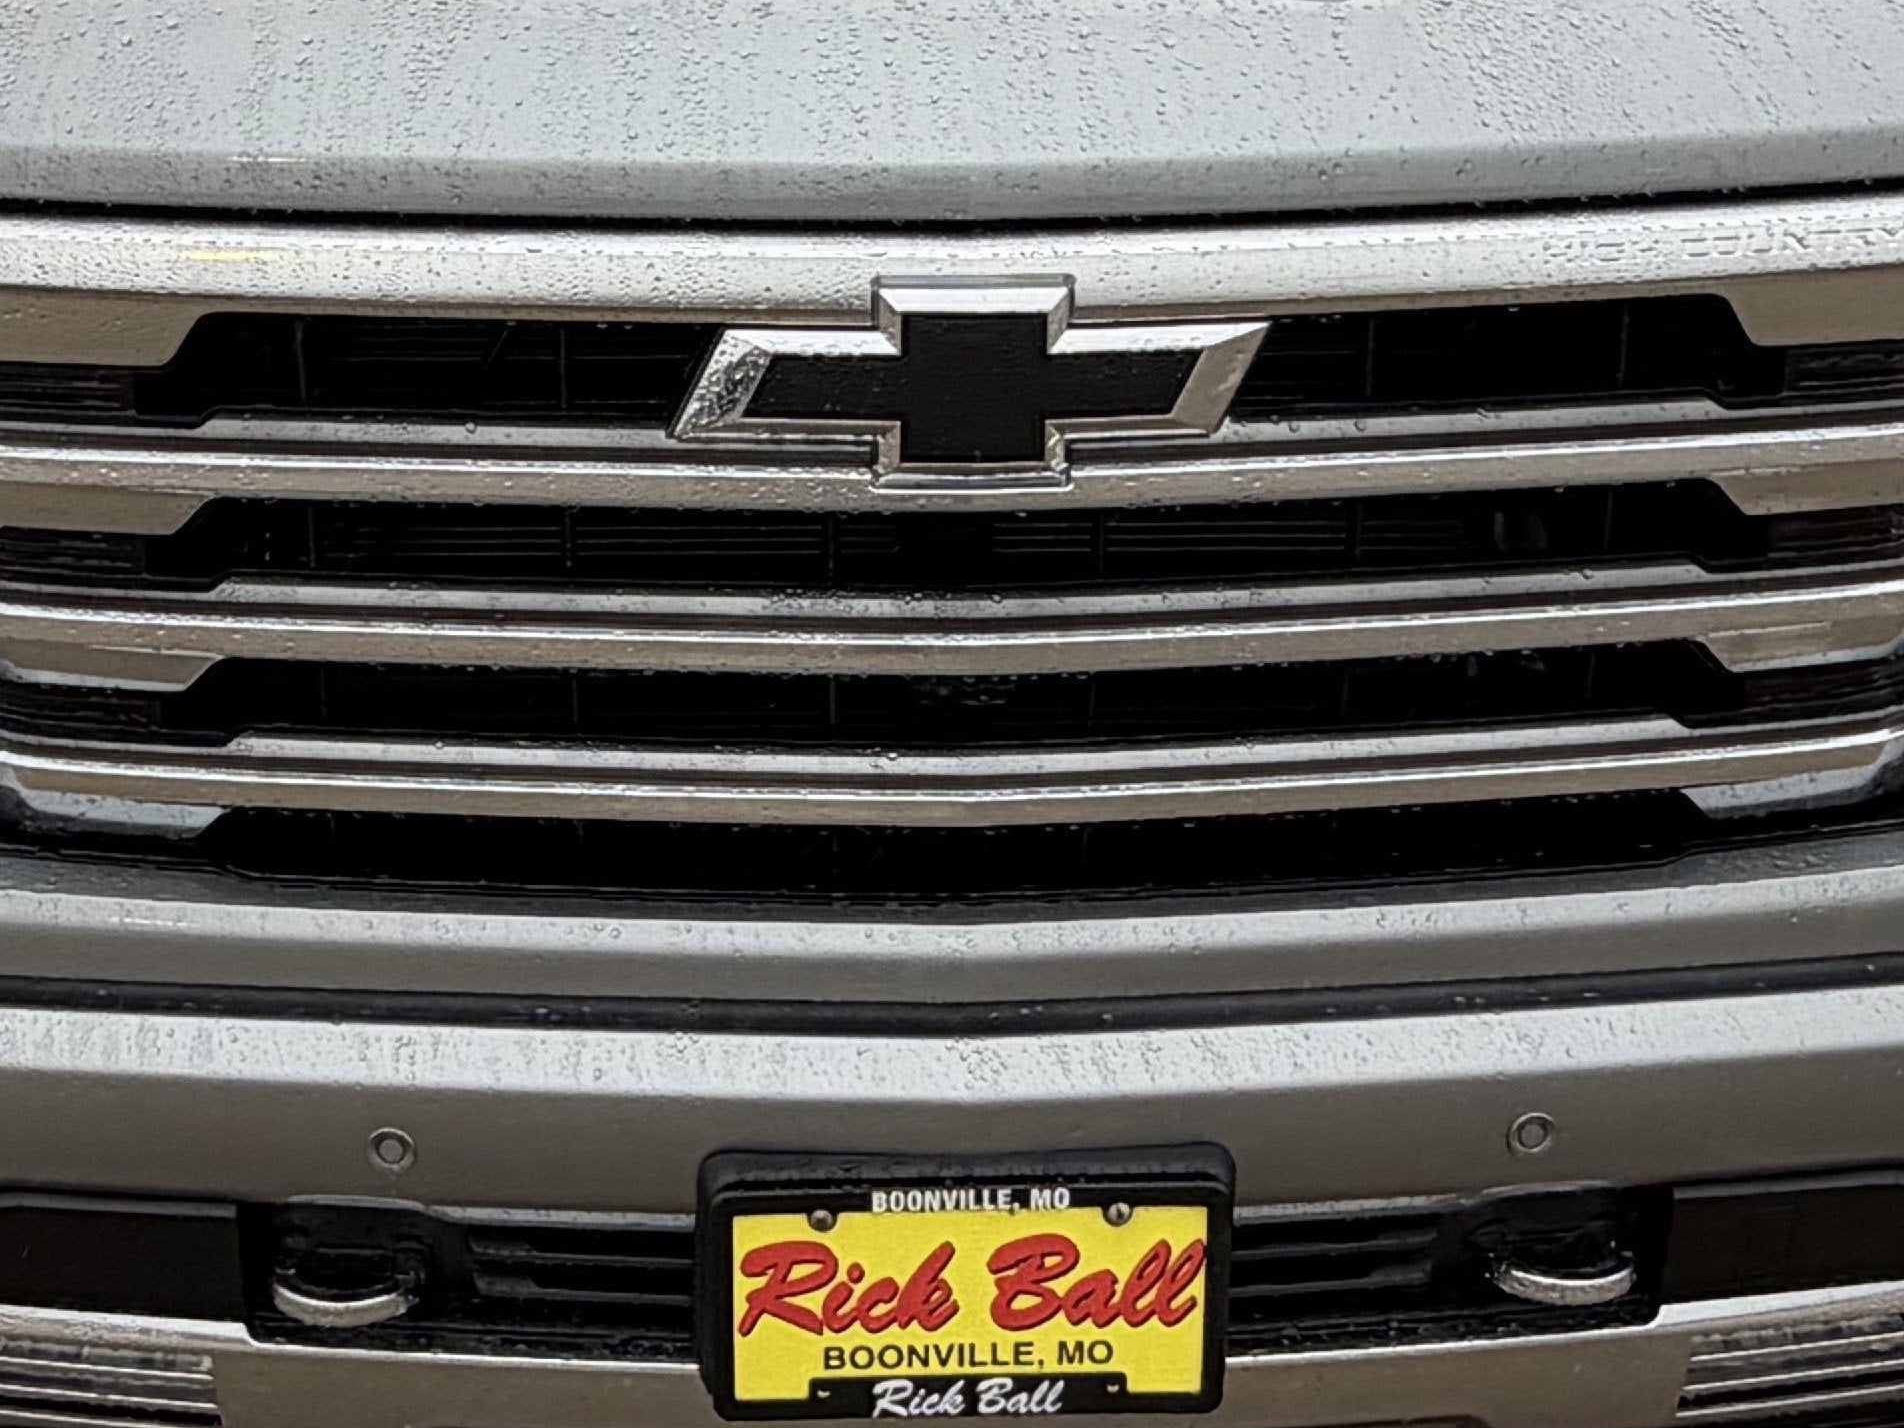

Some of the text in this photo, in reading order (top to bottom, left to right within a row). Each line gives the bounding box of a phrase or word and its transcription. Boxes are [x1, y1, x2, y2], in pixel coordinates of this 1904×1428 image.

[871, 1187, 1070, 1214] BOONVILLE, MO
[738, 1233, 1206, 1336] Rick Ball
[823, 1340, 1114, 1371] BOONVILLE, MO
[871, 1379, 1064, 1419] Rick Ball
